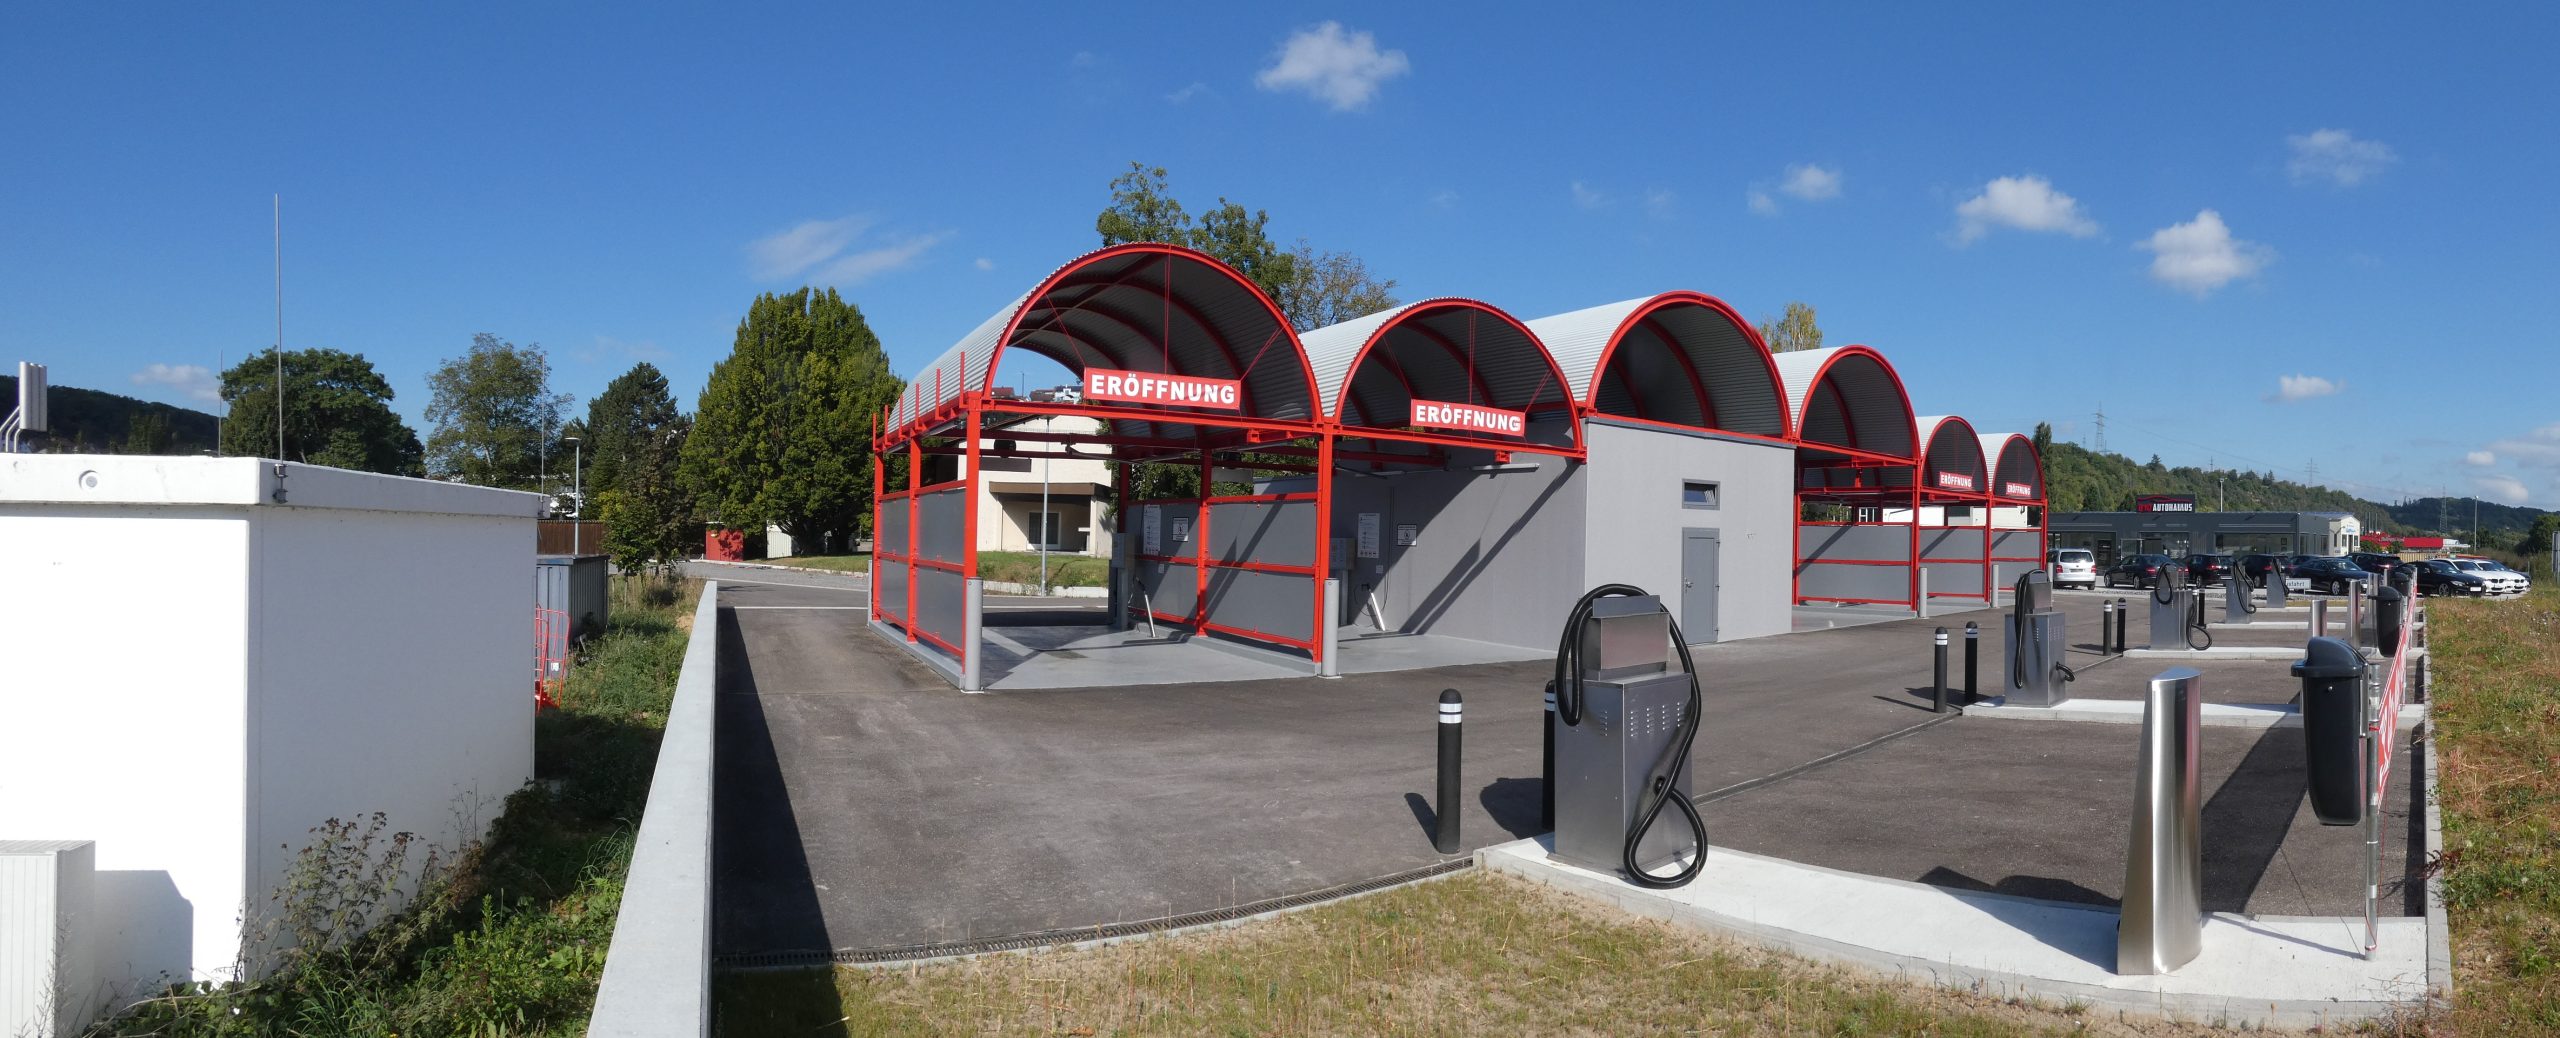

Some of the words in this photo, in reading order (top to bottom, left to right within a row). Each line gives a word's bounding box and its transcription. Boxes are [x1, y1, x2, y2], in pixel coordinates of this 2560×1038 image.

[1091, 373, 1235, 405] ERÖFFNUNG
[1416, 404, 1521, 432] ERÖFFNUNG
[1941, 474, 1971, 487] ERÖFFNUNG
[2007, 484, 2031, 495] ERÖFFNUNG
